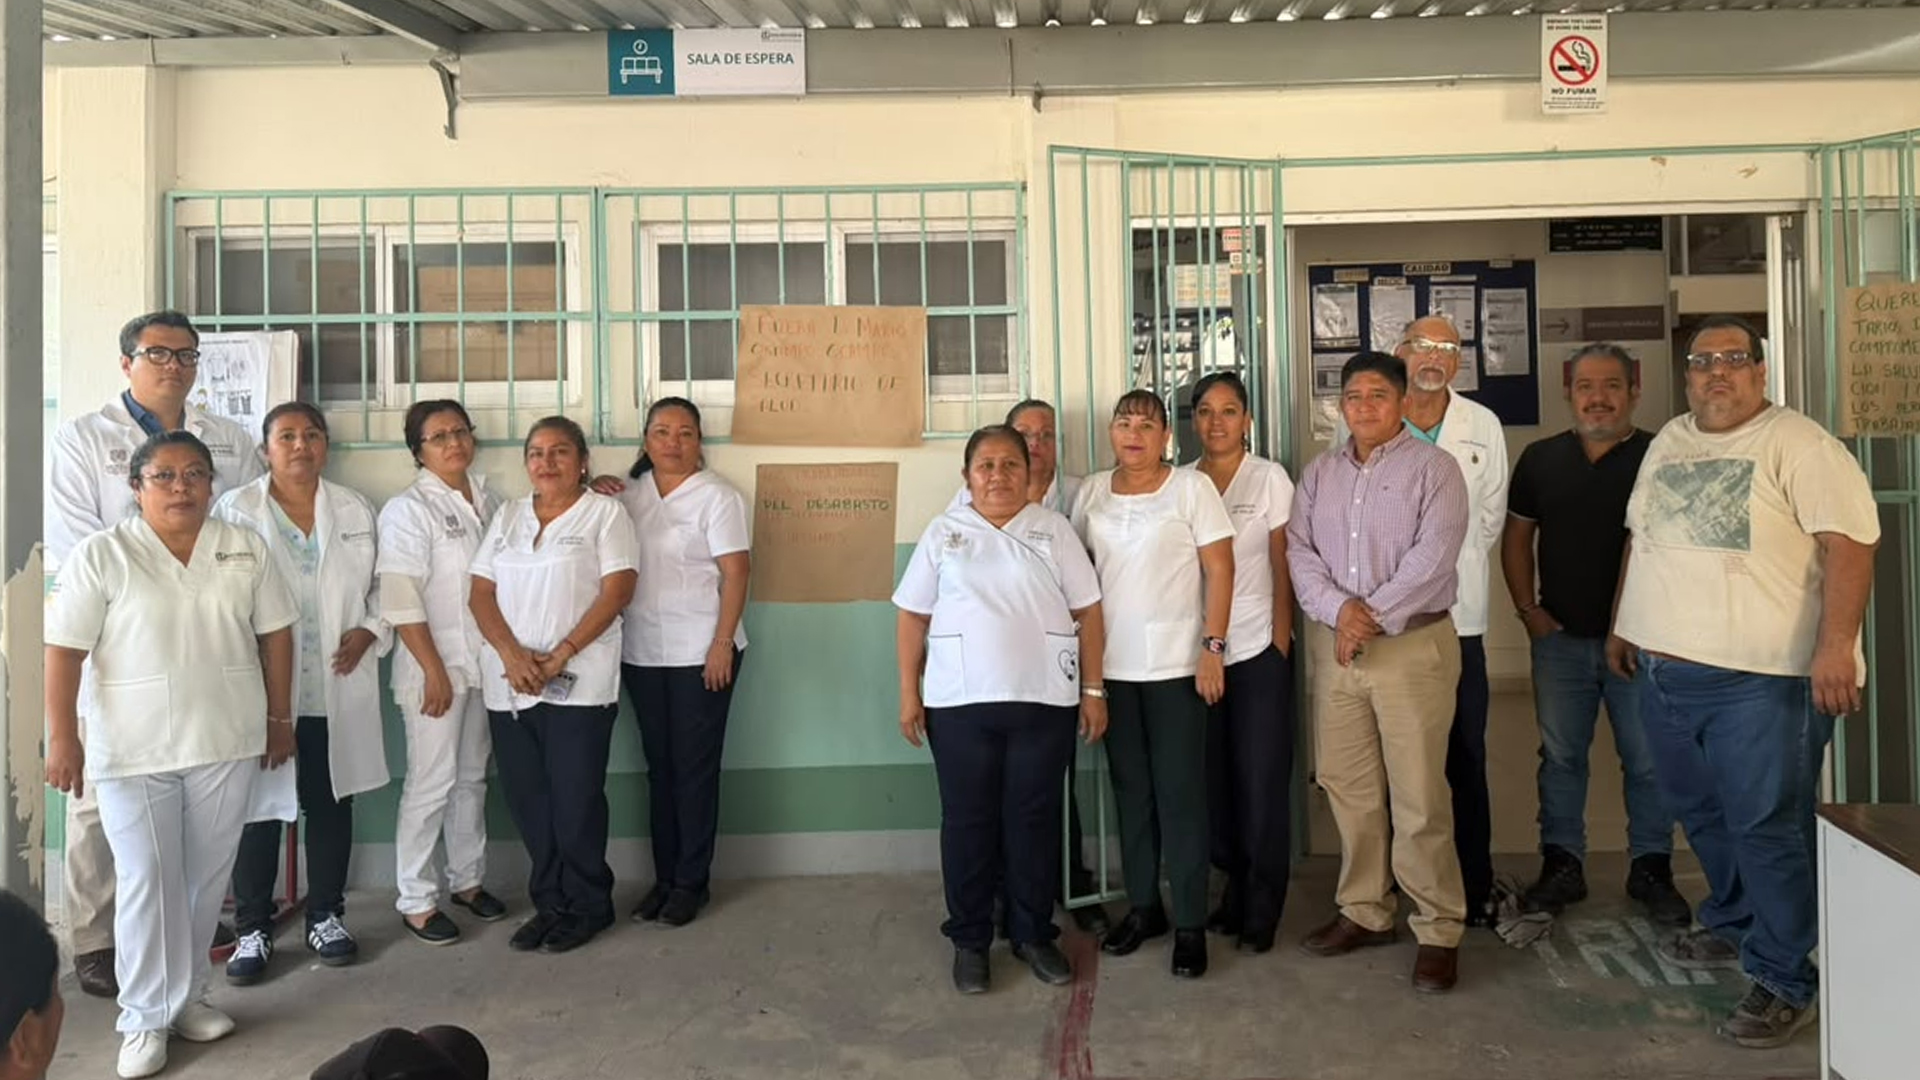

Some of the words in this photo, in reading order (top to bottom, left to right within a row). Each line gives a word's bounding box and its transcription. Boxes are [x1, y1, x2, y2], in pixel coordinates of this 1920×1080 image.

[687, 53, 721, 65] SALA
[725, 53, 741, 65] DE
[746, 53, 794, 65] ESPERA
[1851, 362, 1872, 376] LA
[1851, 400, 1880, 415] LOS
[806, 498, 890, 511] DESABASTO
